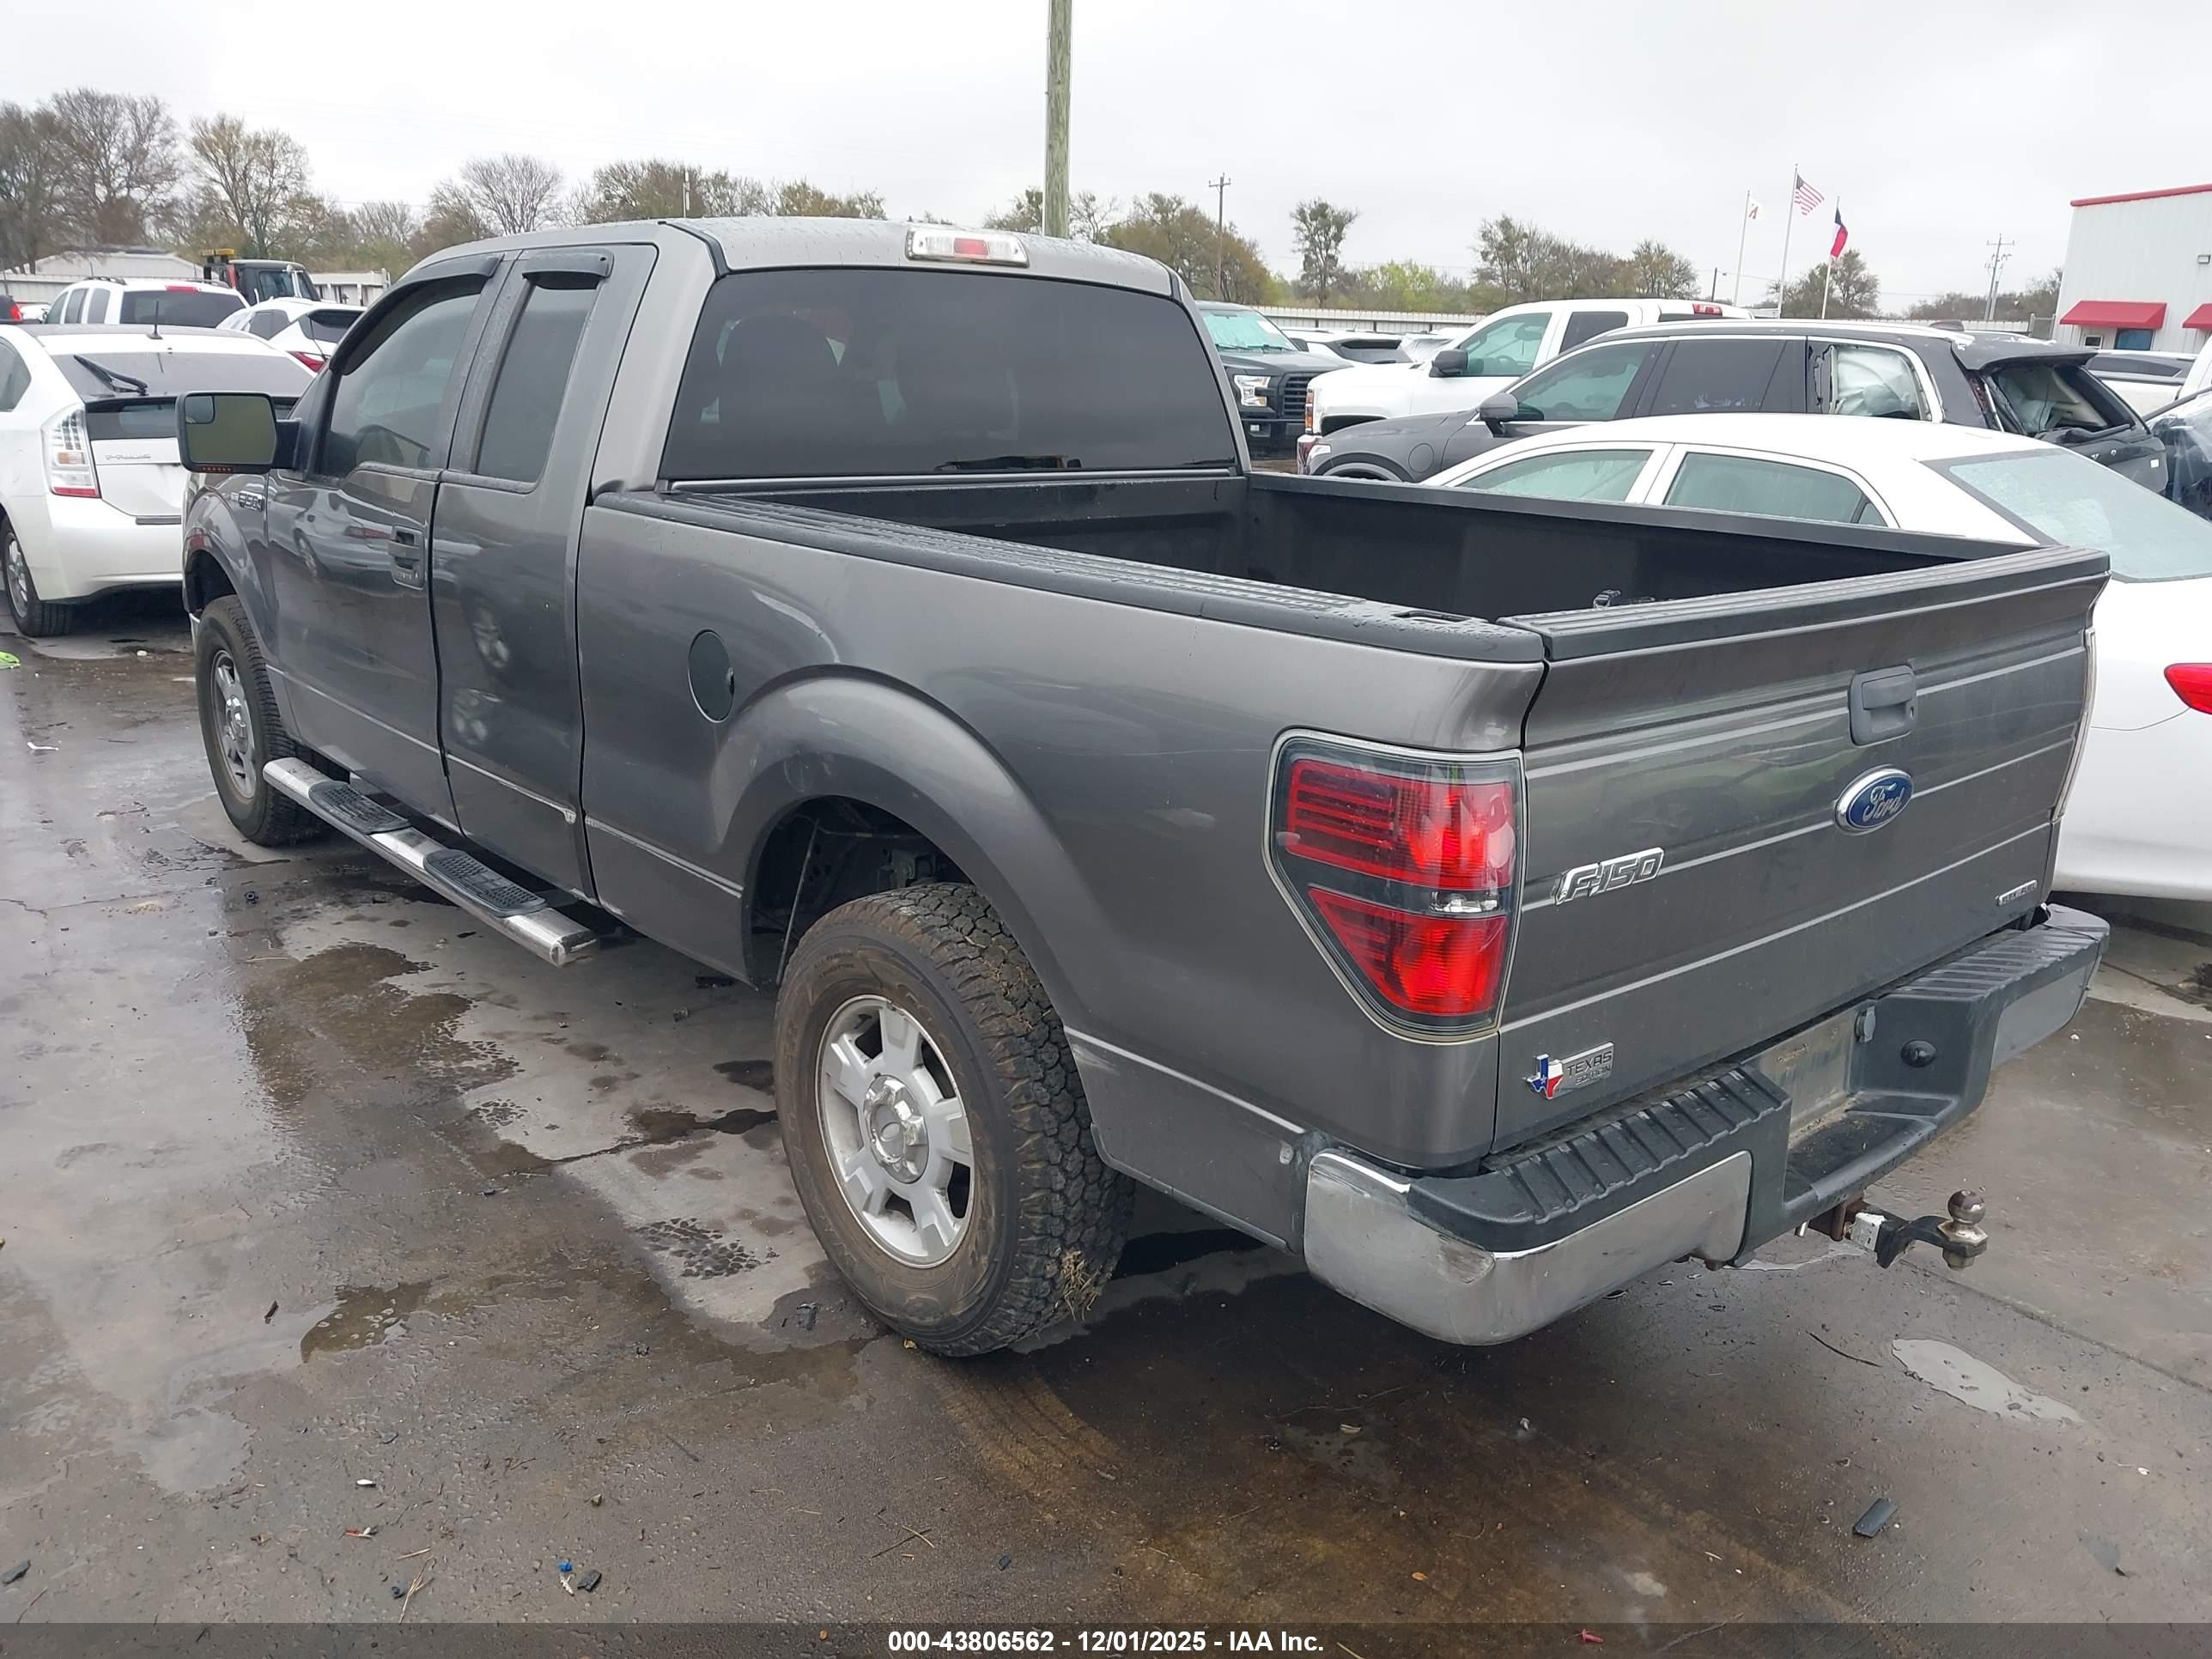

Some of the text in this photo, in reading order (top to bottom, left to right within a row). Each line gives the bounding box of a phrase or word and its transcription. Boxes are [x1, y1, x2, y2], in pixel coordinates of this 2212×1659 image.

[1862, 782, 1905, 823] Ford
[1556, 847, 1665, 905] F-150
[1566, 1050, 1612, 1077] TEXAS
